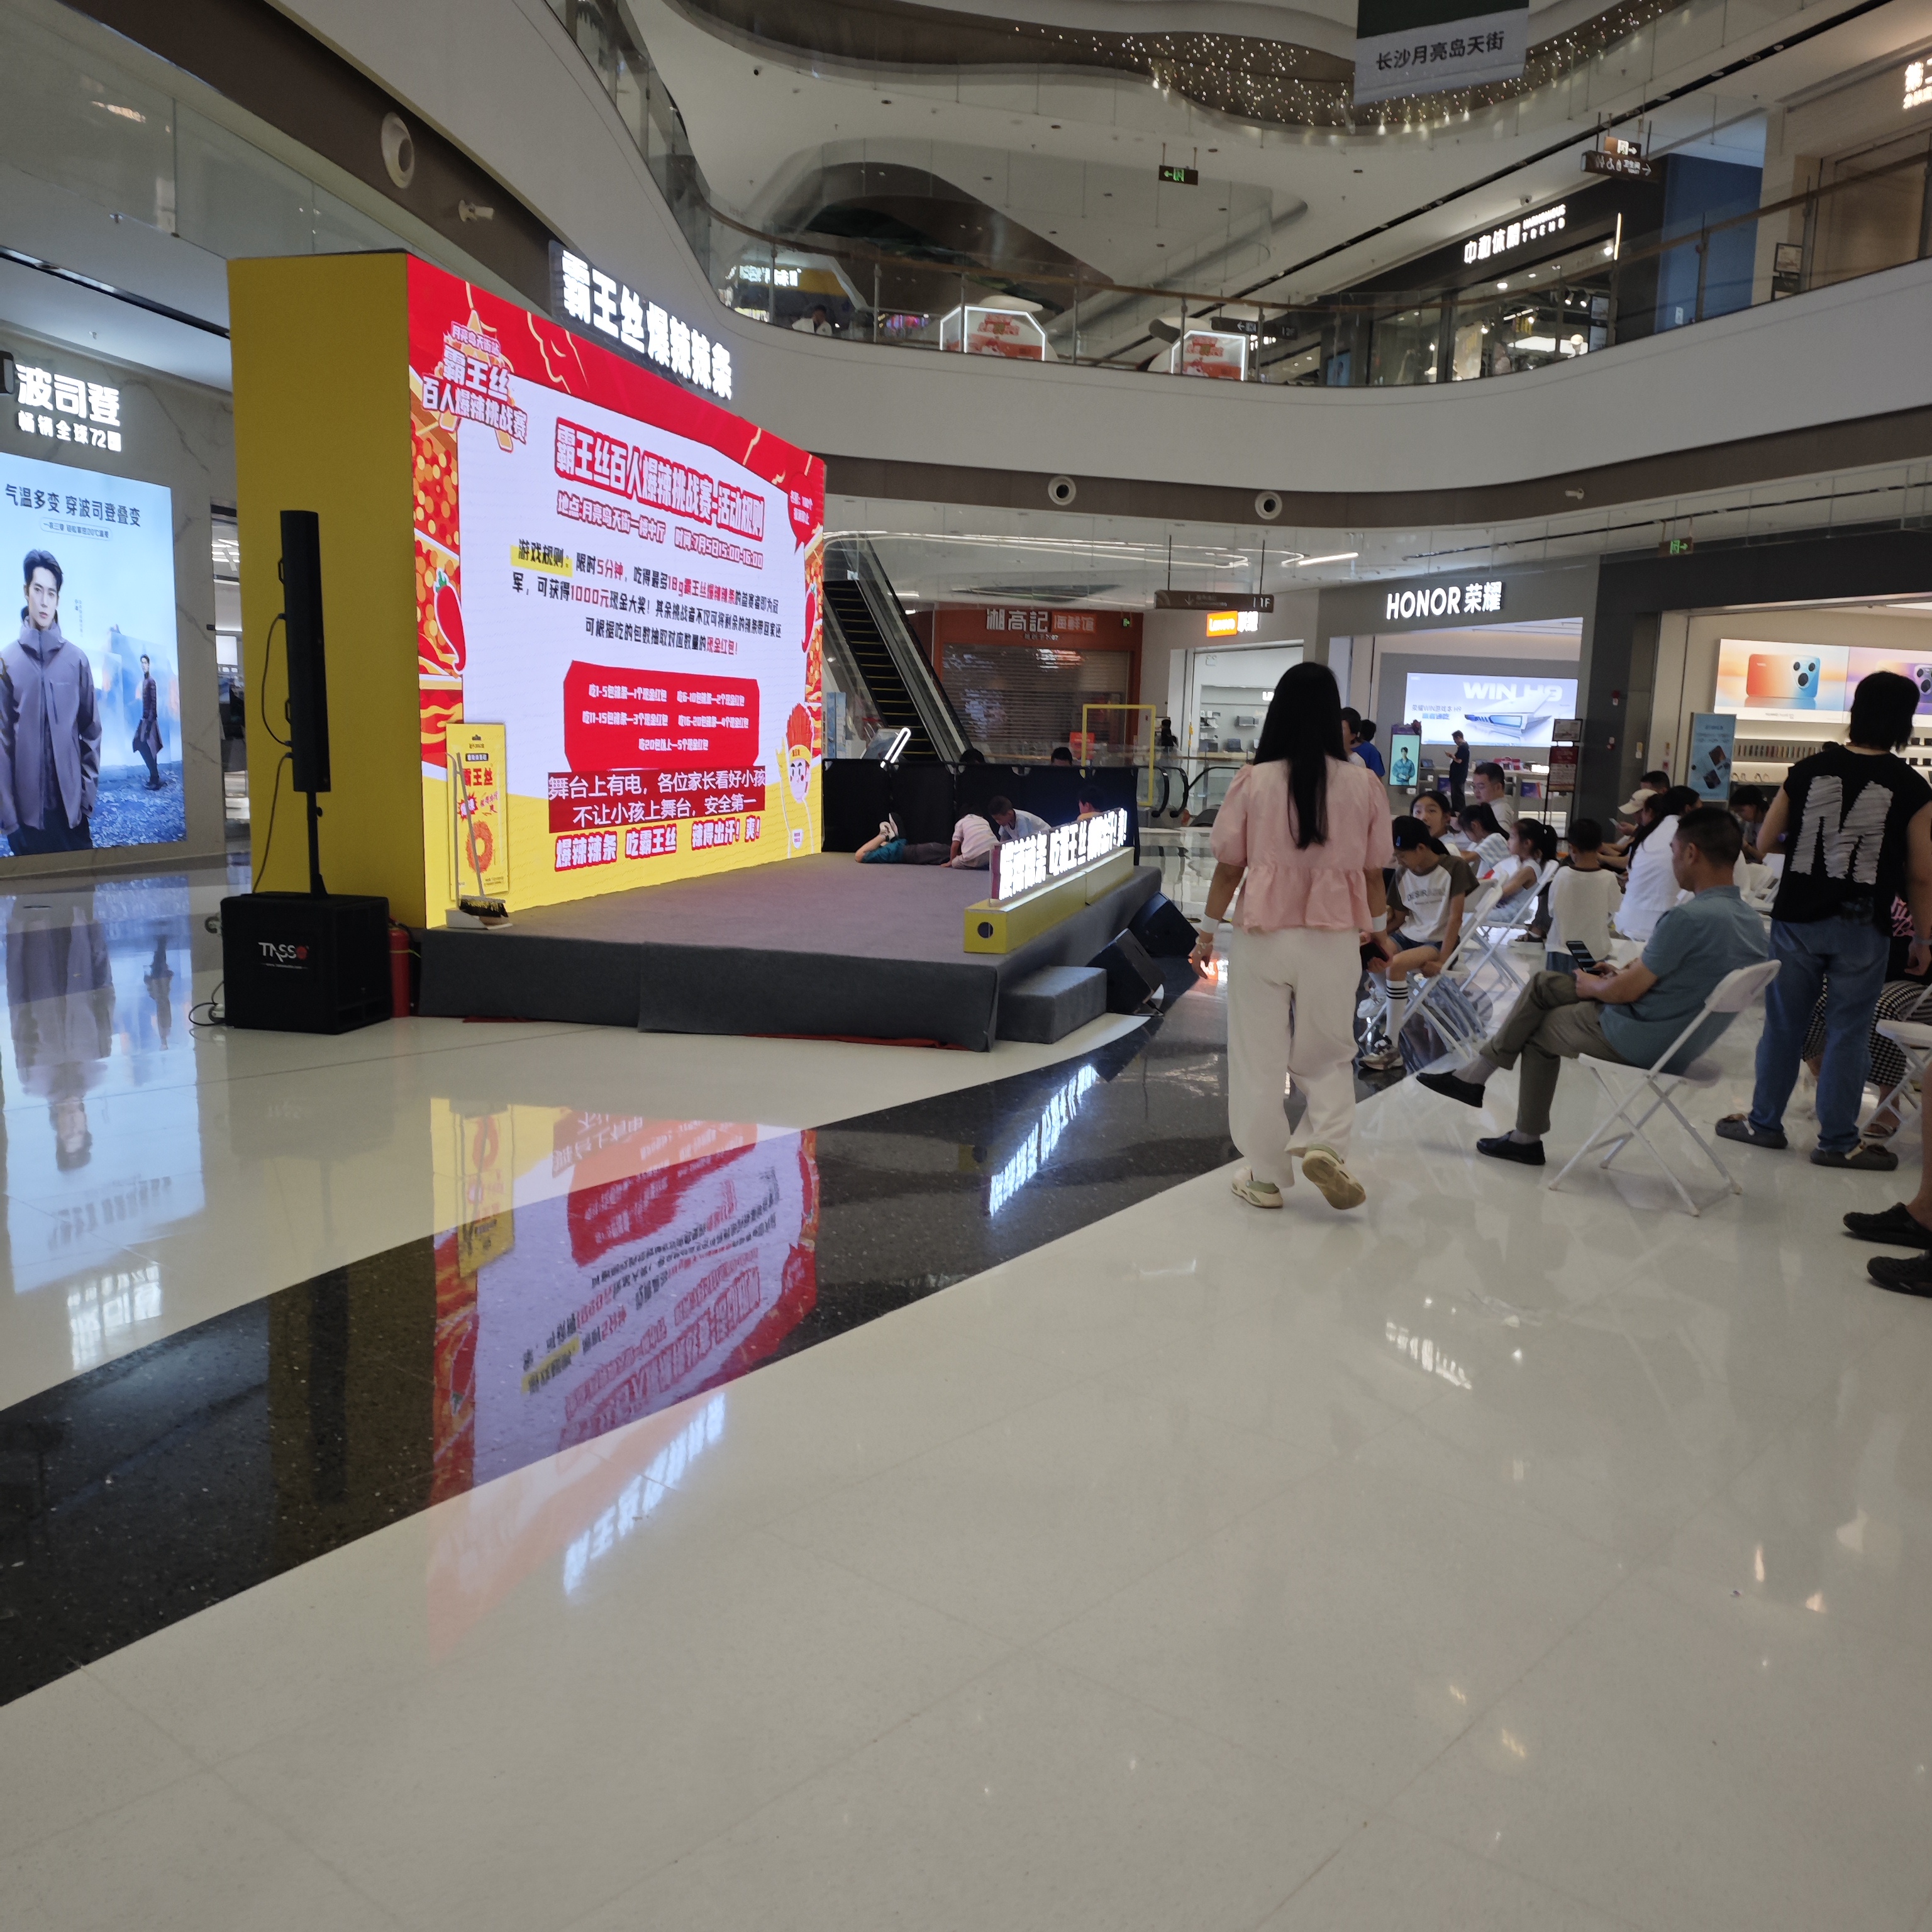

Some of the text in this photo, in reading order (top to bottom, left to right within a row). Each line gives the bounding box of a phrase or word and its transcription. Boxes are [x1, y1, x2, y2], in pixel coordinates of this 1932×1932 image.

[1376, 31, 1504, 70] 长沙月亮岛天街
[443, 344, 509, 401] 霸王丝
[15, 364, 121, 426] 波司登
[423, 375, 528, 445] 百人爆辣挑战赛
[18, 410, 122, 452] 畅销全球72国
[6, 484, 141, 528] 气温多变 穿波司登叠变
[1387, 581, 1502, 620] HONOR 荣耀
[1462, 681, 1516, 700] WIN
[555, 833, 617, 870] 爆辣辣条
[625, 825, 677, 858] 吃霸王丝
